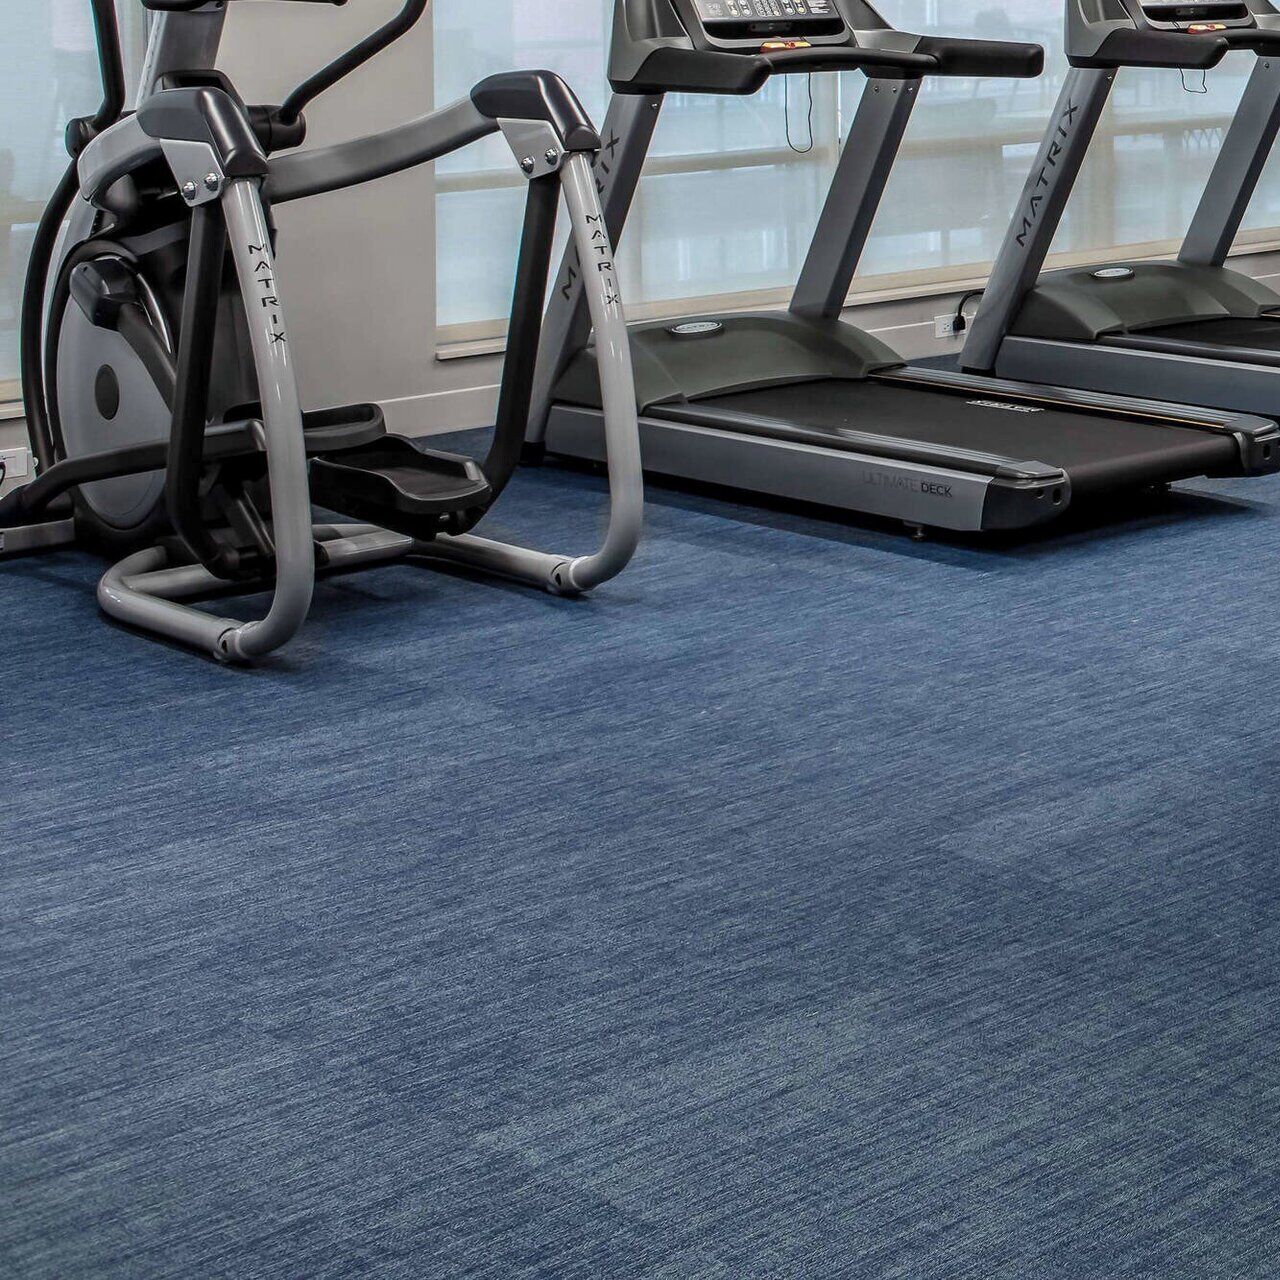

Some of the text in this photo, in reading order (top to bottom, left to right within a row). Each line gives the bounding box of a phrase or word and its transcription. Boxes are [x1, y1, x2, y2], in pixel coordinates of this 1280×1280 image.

[1016, 98, 1079, 248] MATRIX
[248, 244, 286, 344] MATRIX
[586, 214, 620, 304] MATRIX
[920, 481, 953, 498] DECK
